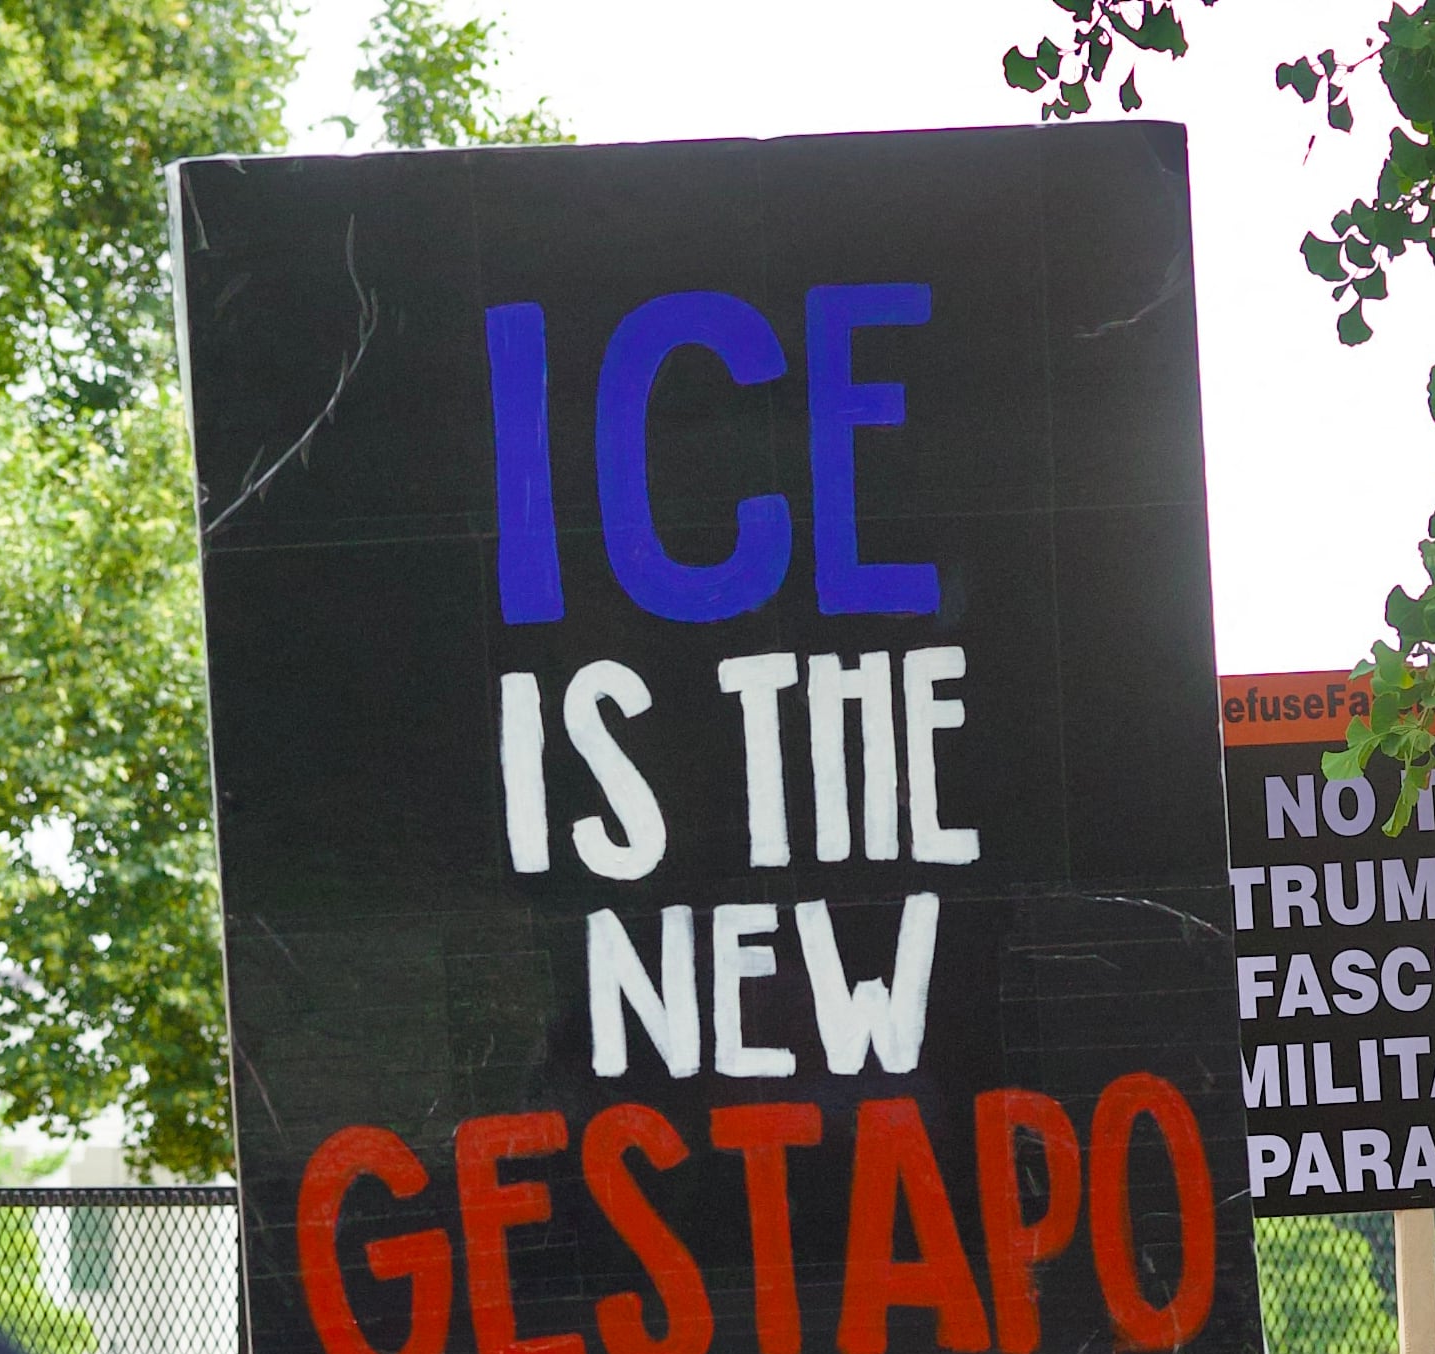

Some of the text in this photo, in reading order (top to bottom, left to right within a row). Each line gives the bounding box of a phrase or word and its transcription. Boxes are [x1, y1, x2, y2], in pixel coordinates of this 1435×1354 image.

[486, 282, 941, 625] ICE
[500, 646, 981, 881] IS THE
[1265, 773, 1377, 839] NO
[586, 890, 940, 1078] NEW
